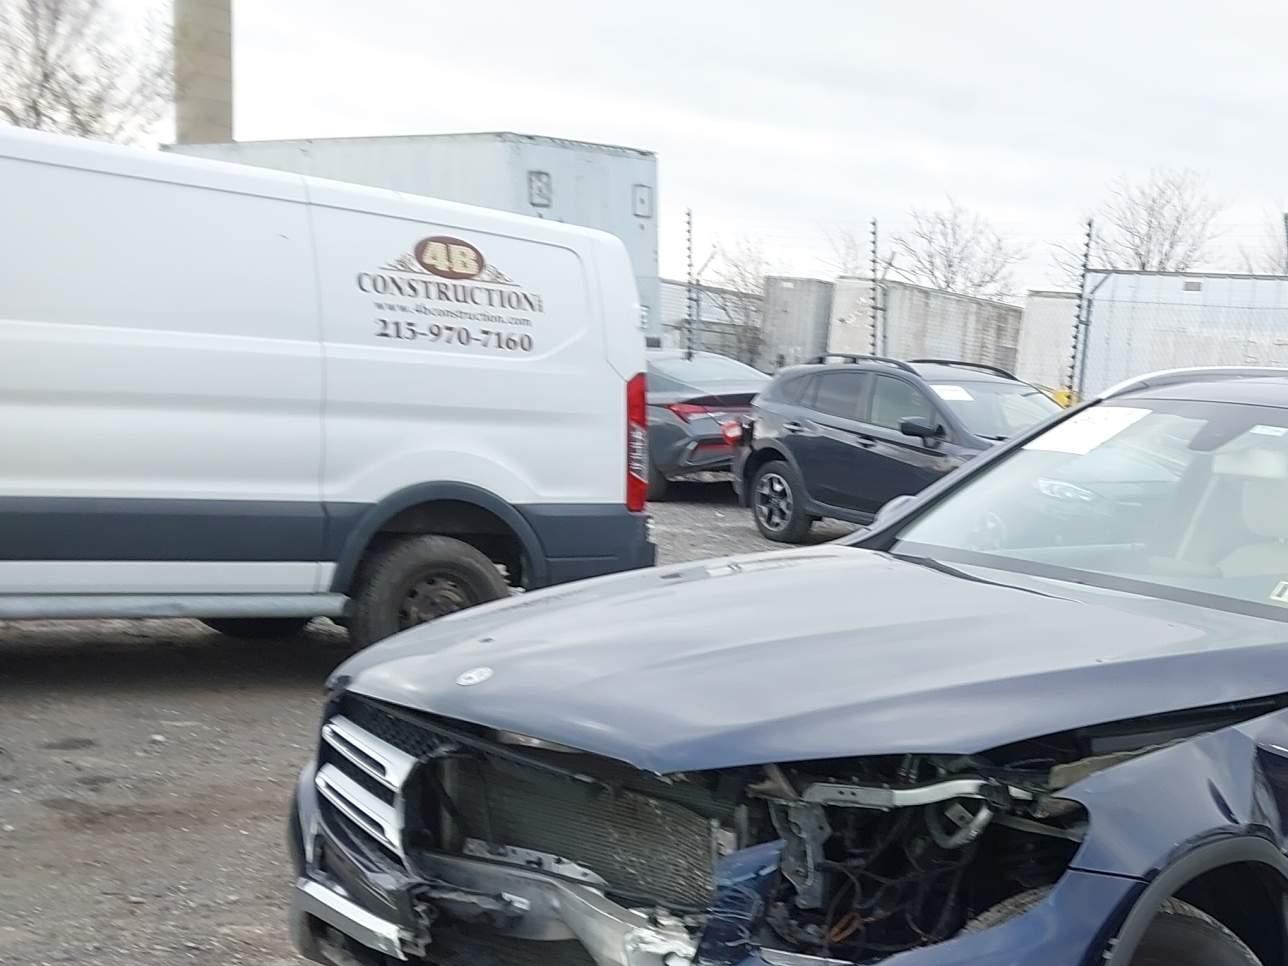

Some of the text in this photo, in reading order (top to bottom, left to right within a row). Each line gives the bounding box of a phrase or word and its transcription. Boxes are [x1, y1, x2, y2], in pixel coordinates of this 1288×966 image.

[422, 240, 480, 276] 4B
[357, 271, 540, 313] CONSTRUCTION
[373, 301, 533, 327] www.4bconstruction.com
[375, 318, 533, 352] 215-970-7160
